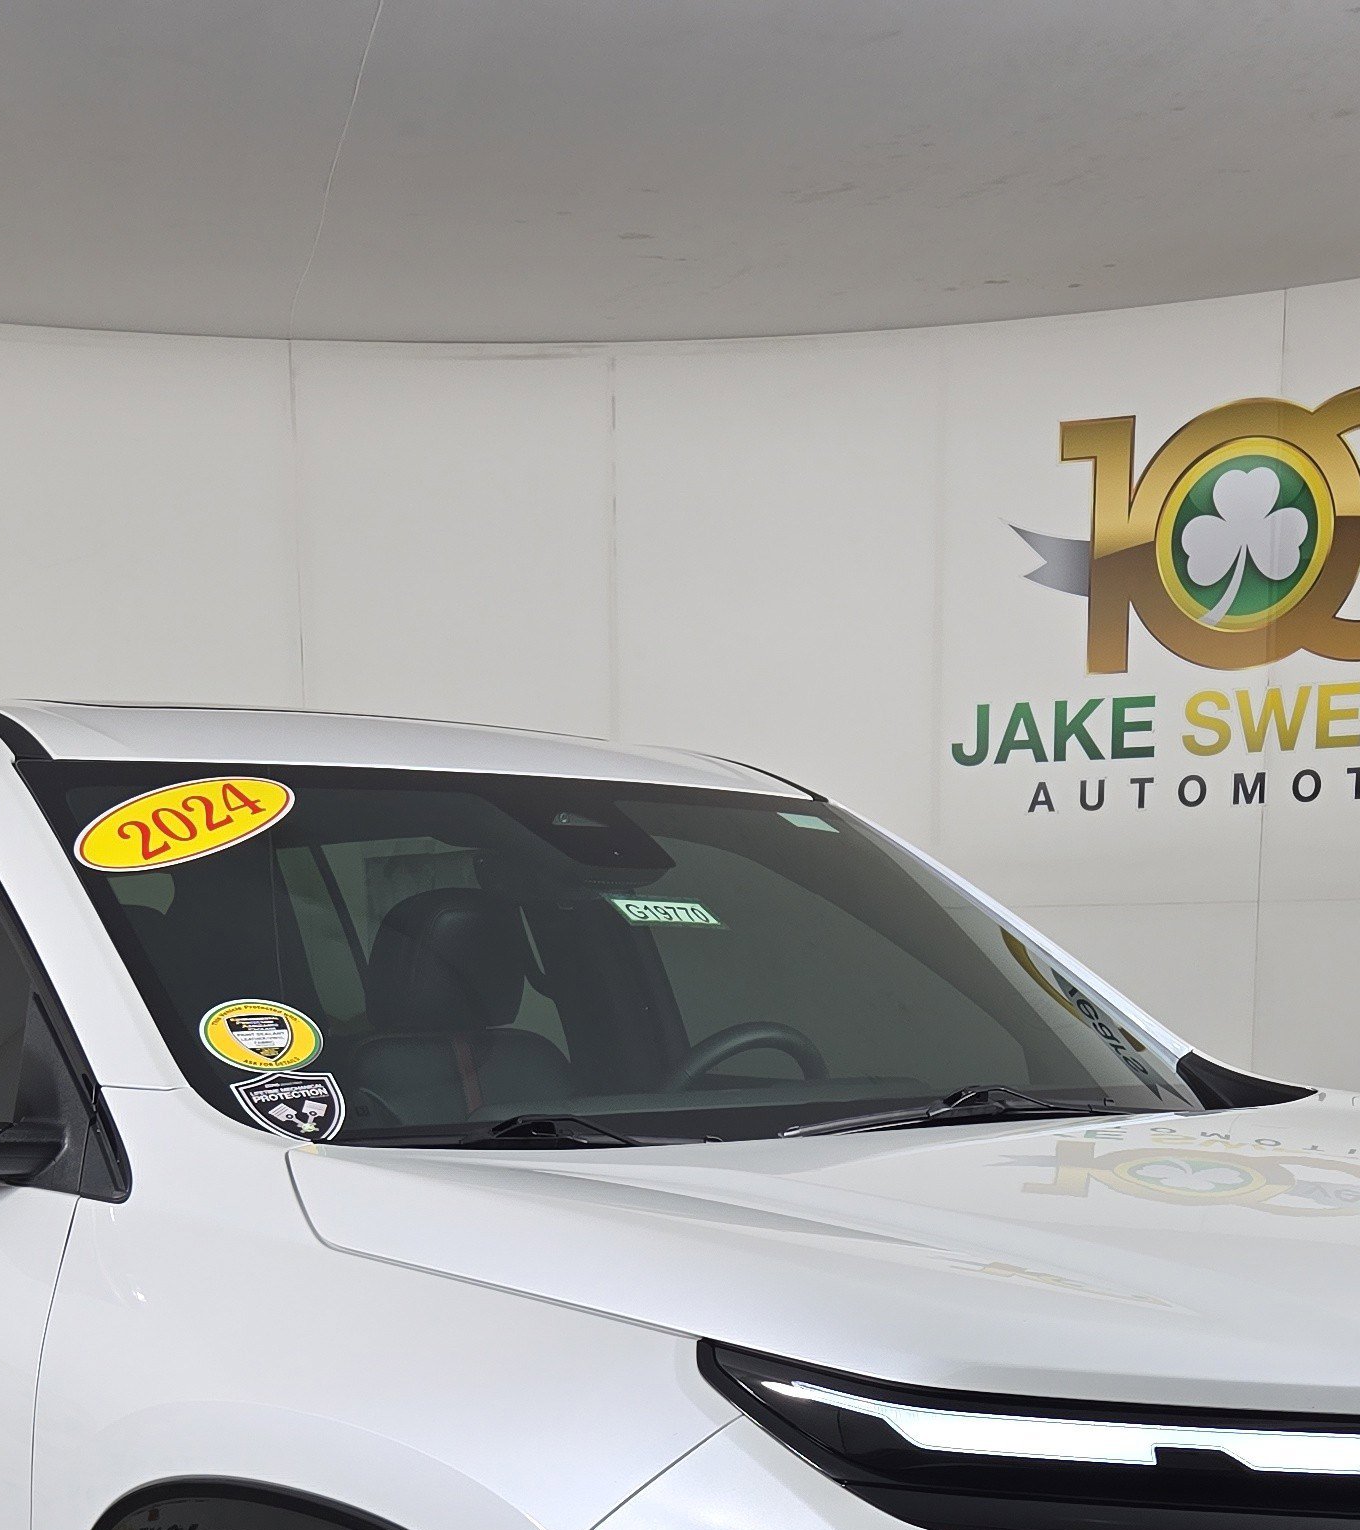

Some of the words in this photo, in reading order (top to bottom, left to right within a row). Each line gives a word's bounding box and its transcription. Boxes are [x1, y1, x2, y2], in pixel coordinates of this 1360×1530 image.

[951, 694, 1157, 768] JAKE
[117, 782, 263, 862] 2024
[625, 903, 711, 924] G19770
[251, 1087, 328, 1104] PROTECTION
